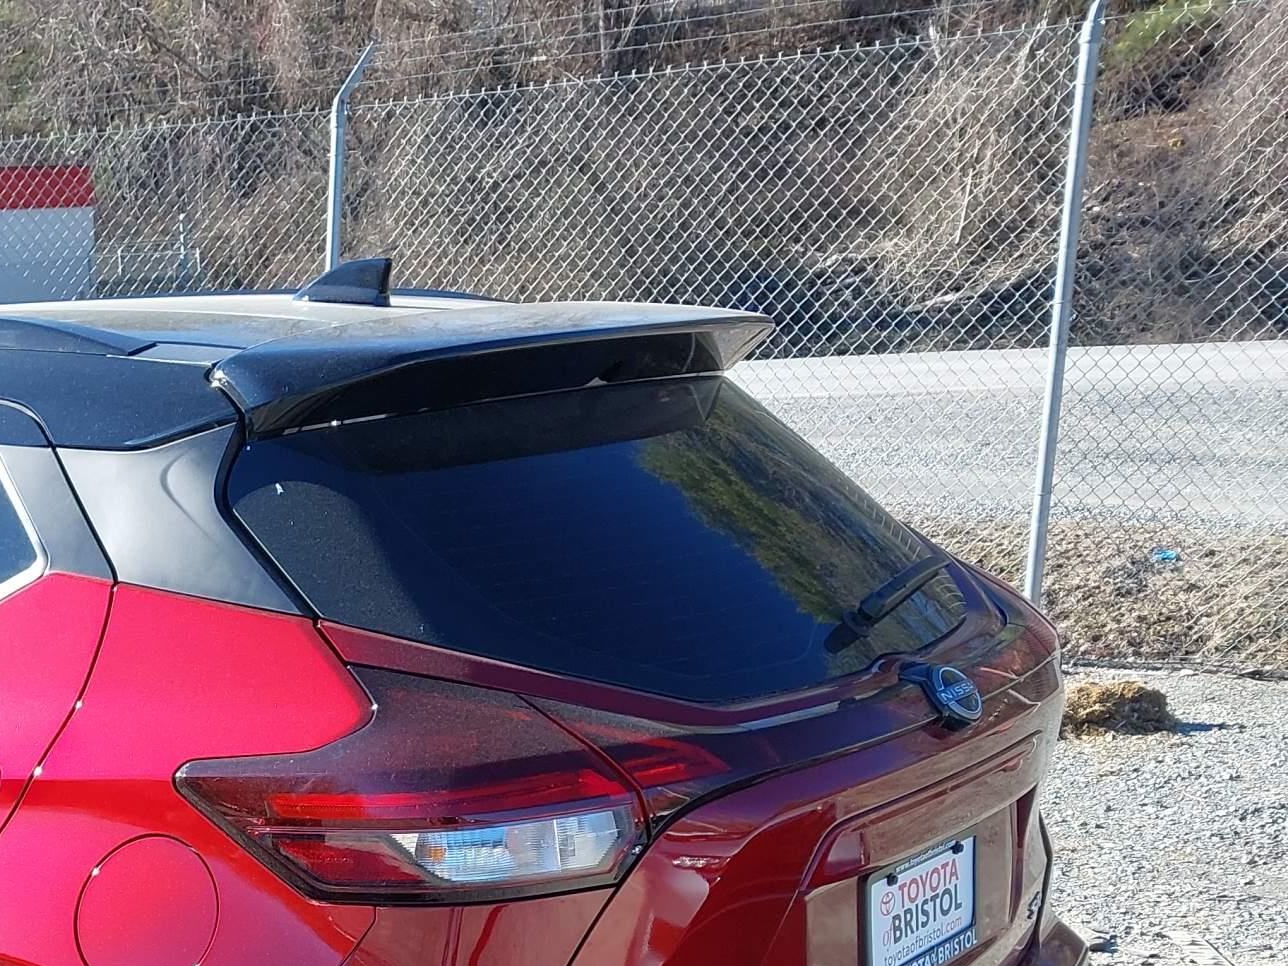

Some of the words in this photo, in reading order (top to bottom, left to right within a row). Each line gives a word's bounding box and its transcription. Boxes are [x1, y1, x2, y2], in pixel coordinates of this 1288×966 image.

[940, 682, 974, 701] NISS
[898, 858, 959, 909] TOYOTA
[892, 884, 962, 945] BRISTOL
[938, 928, 978, 966] BRISTOL
